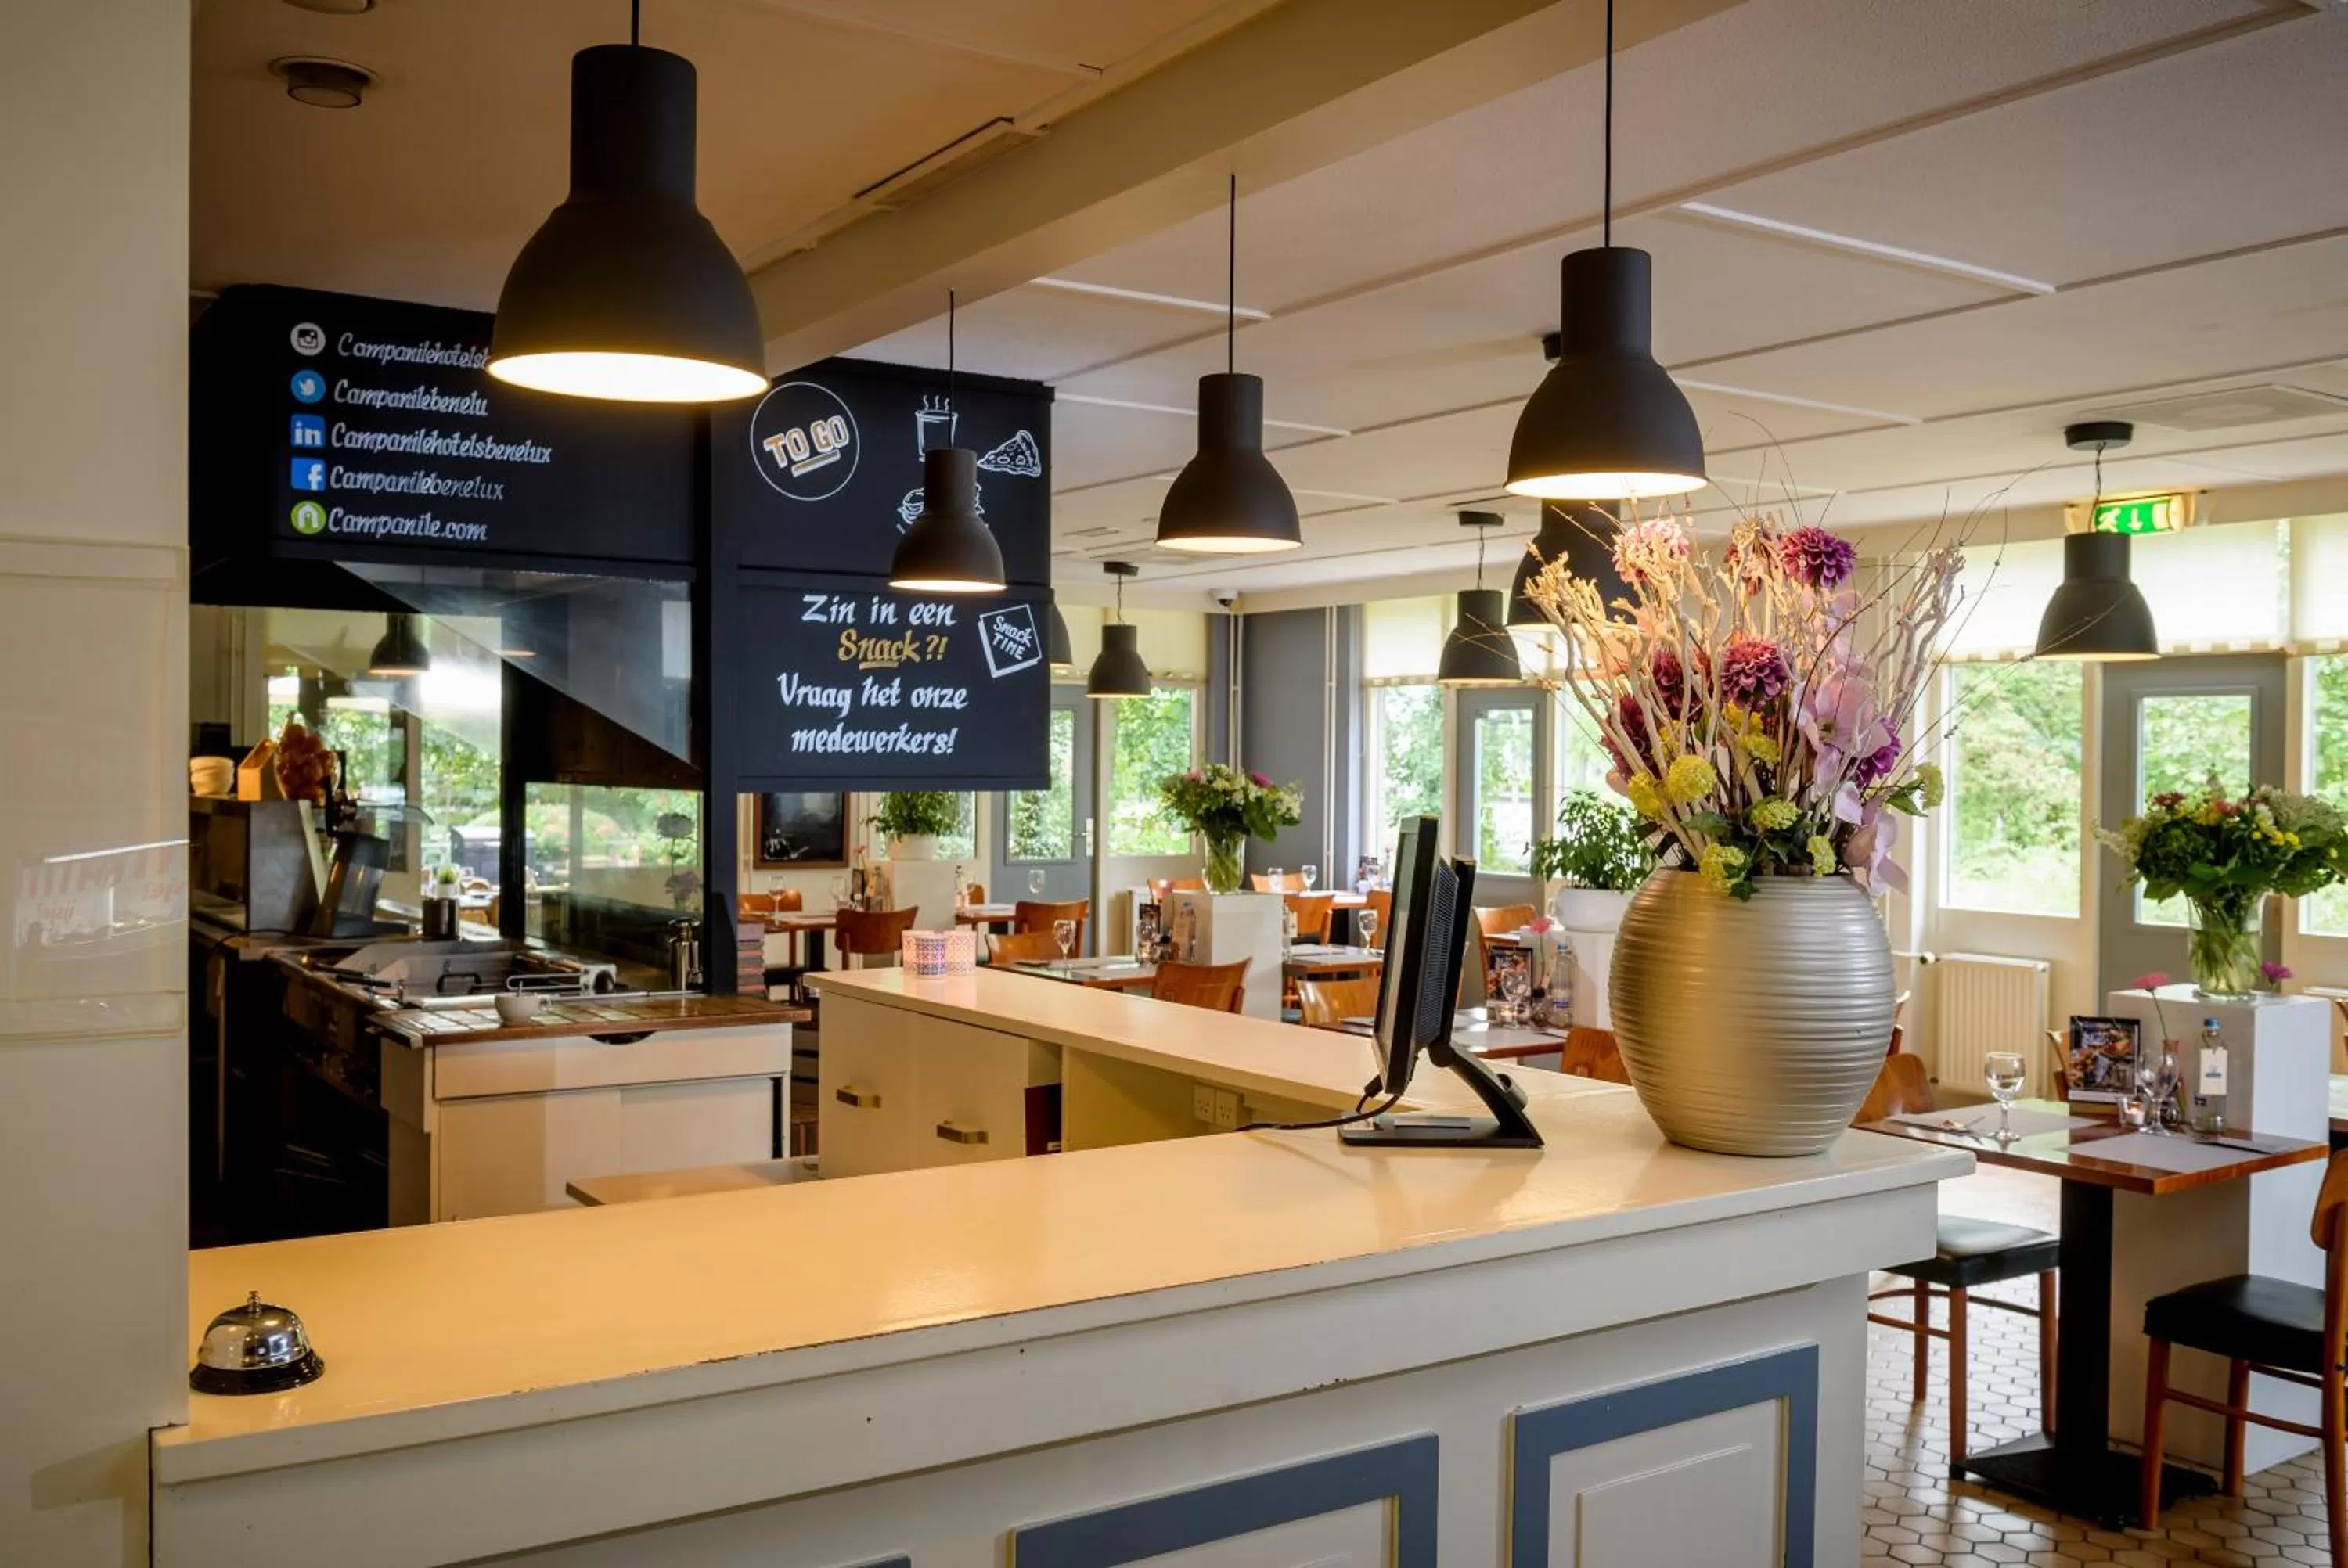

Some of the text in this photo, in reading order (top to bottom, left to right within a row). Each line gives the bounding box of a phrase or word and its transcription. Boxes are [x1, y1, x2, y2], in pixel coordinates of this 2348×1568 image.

[331, 422, 553, 464] Campanilehotelsbenelux
[763, 414, 850, 469] TO GO
[330, 466, 505, 501] Campanilebenelux
[327, 507, 488, 541] Campanile.com
[801, 594, 957, 627] Zin in een
[992, 616, 1032, 649] Snack
[992, 631, 1026, 660] TIME
[776, 672, 969, 718] Vraag het onze
[791, 721, 959, 755] medewerkers!
